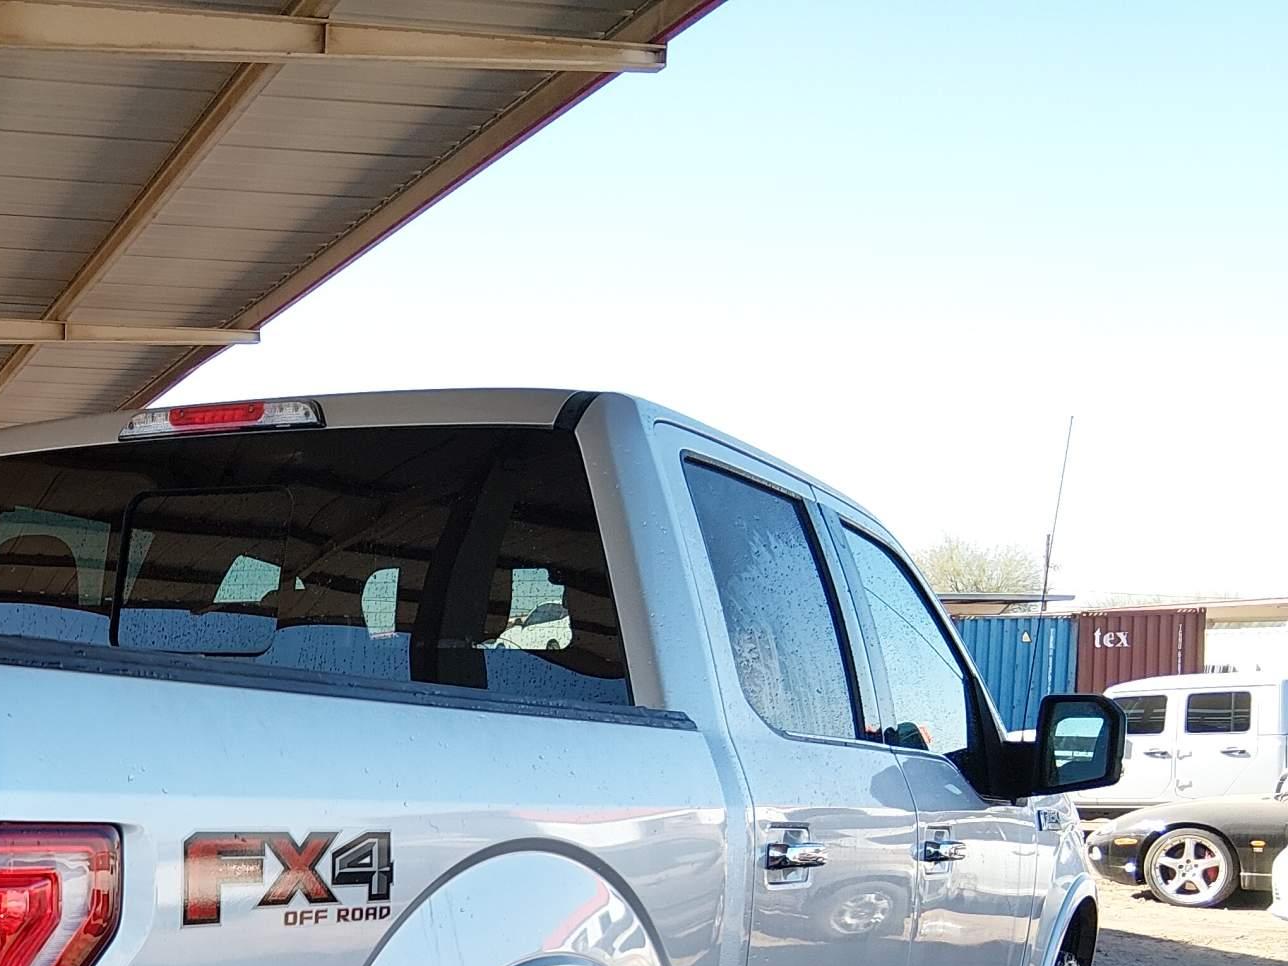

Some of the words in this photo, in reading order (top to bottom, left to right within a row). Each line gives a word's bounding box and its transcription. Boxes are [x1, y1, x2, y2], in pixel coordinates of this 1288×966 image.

[1094, 627, 1130, 648] tex
[181, 831, 394, 927] FX4
[283, 907, 329, 926] OFF
[337, 905, 391, 923] ROAD
